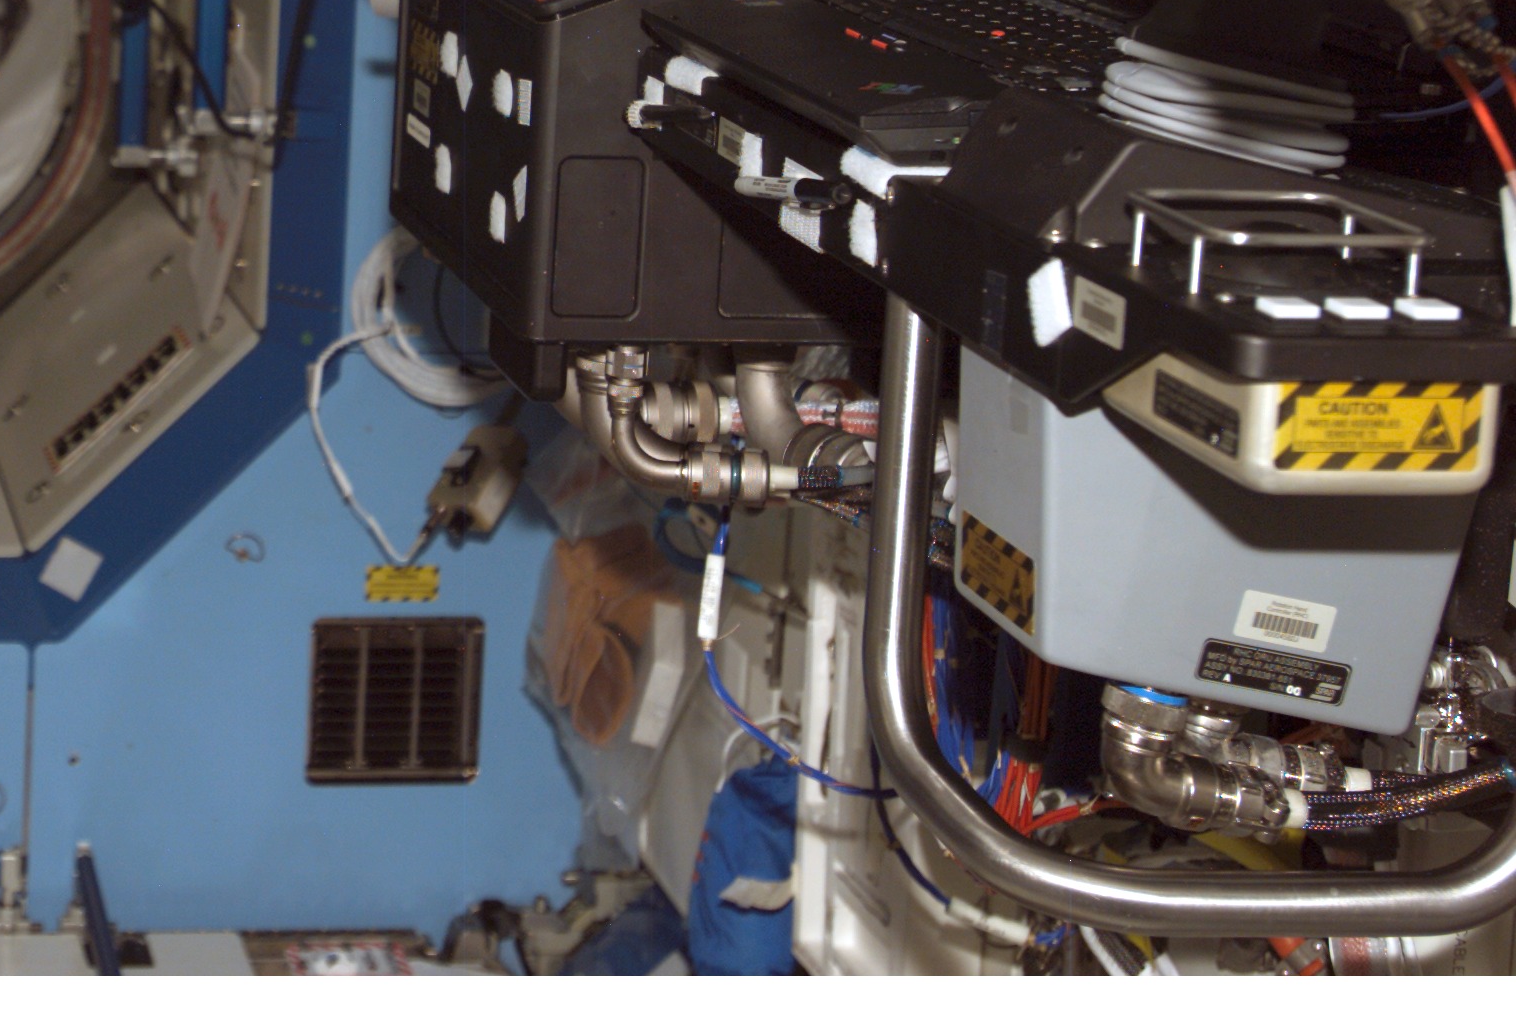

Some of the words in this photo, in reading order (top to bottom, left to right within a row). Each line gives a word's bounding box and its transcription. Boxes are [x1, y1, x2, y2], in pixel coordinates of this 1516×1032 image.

[1318, 401, 1388, 415] CAUTION
[1262, 662, 1314, 679] AEROSPACE
[1274, 656, 1318, 671] ASSEMBLY
[1222, 672, 1232, 682] A
